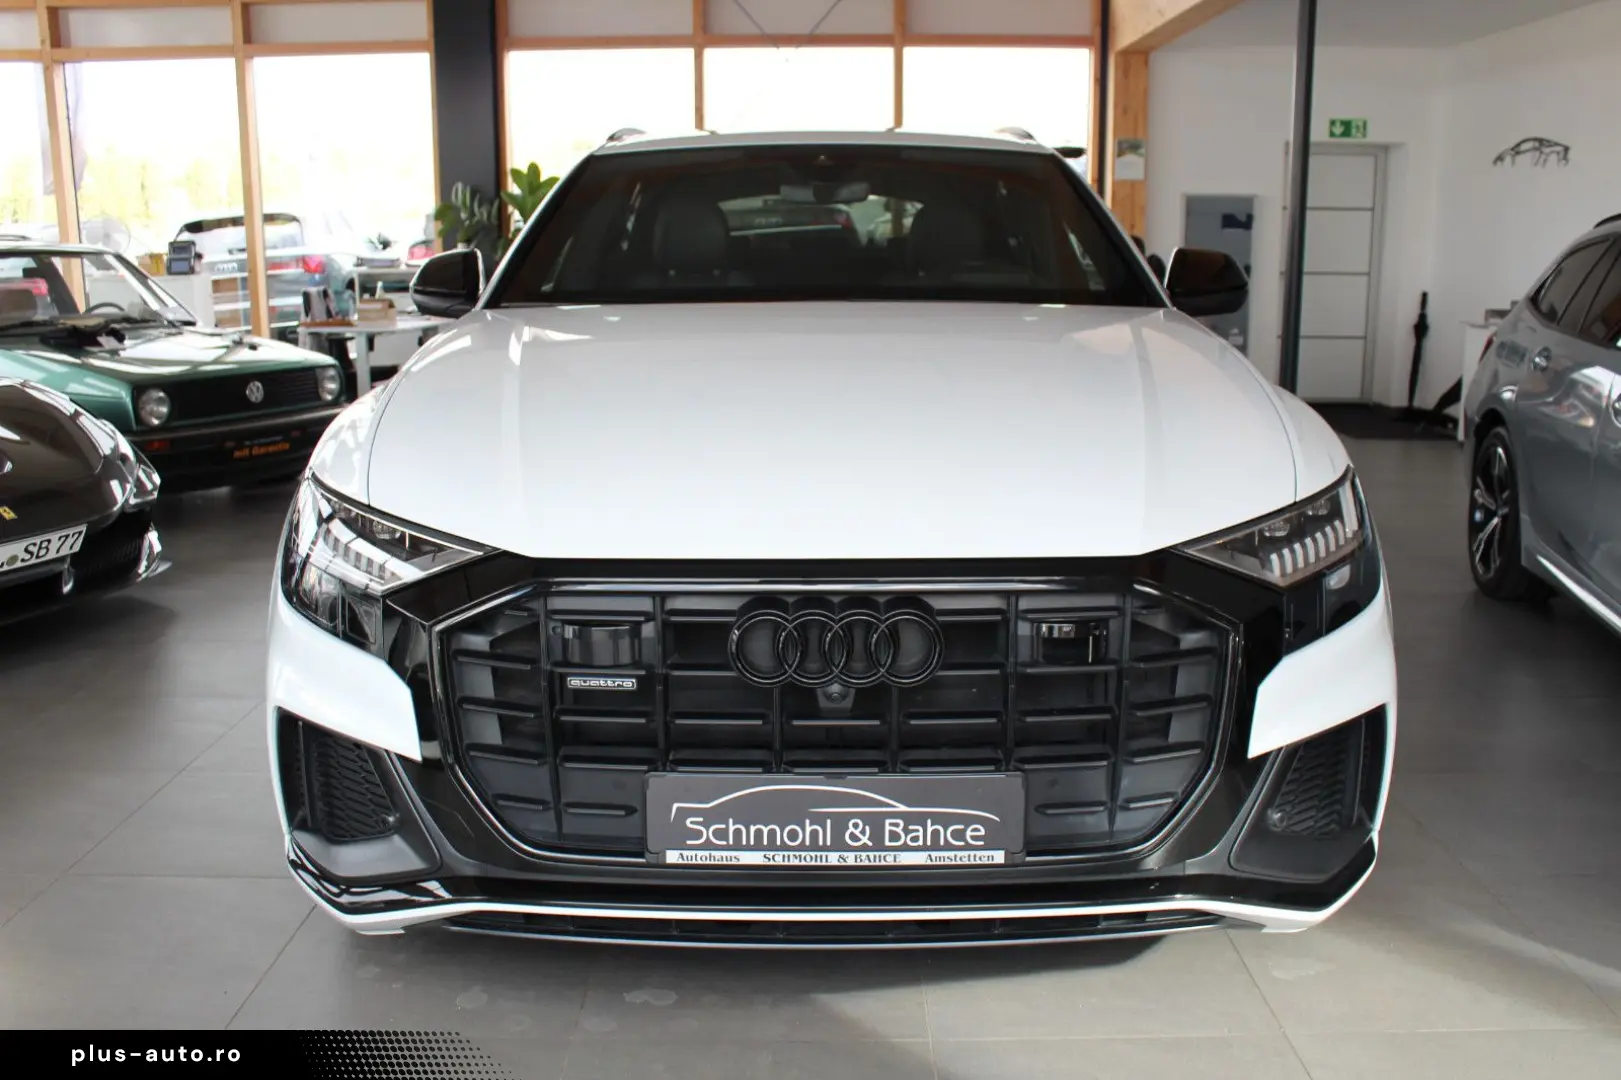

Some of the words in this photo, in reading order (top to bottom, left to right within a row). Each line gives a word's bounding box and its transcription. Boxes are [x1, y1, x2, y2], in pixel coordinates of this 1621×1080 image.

[20, 538, 52, 563] SB
[55, 530, 84, 555] 77
[569, 679, 633, 688] quattro
[685, 817, 832, 847] Schmohl
[844, 818, 873, 847] &
[884, 818, 986, 847] Bahce
[676, 852, 741, 863] Autohaus
[763, 853, 833, 864] SCHMOHL
[837, 853, 850, 864] &
[854, 853, 902, 864] BAHCE
[924, 853, 995, 863] Amstetten
